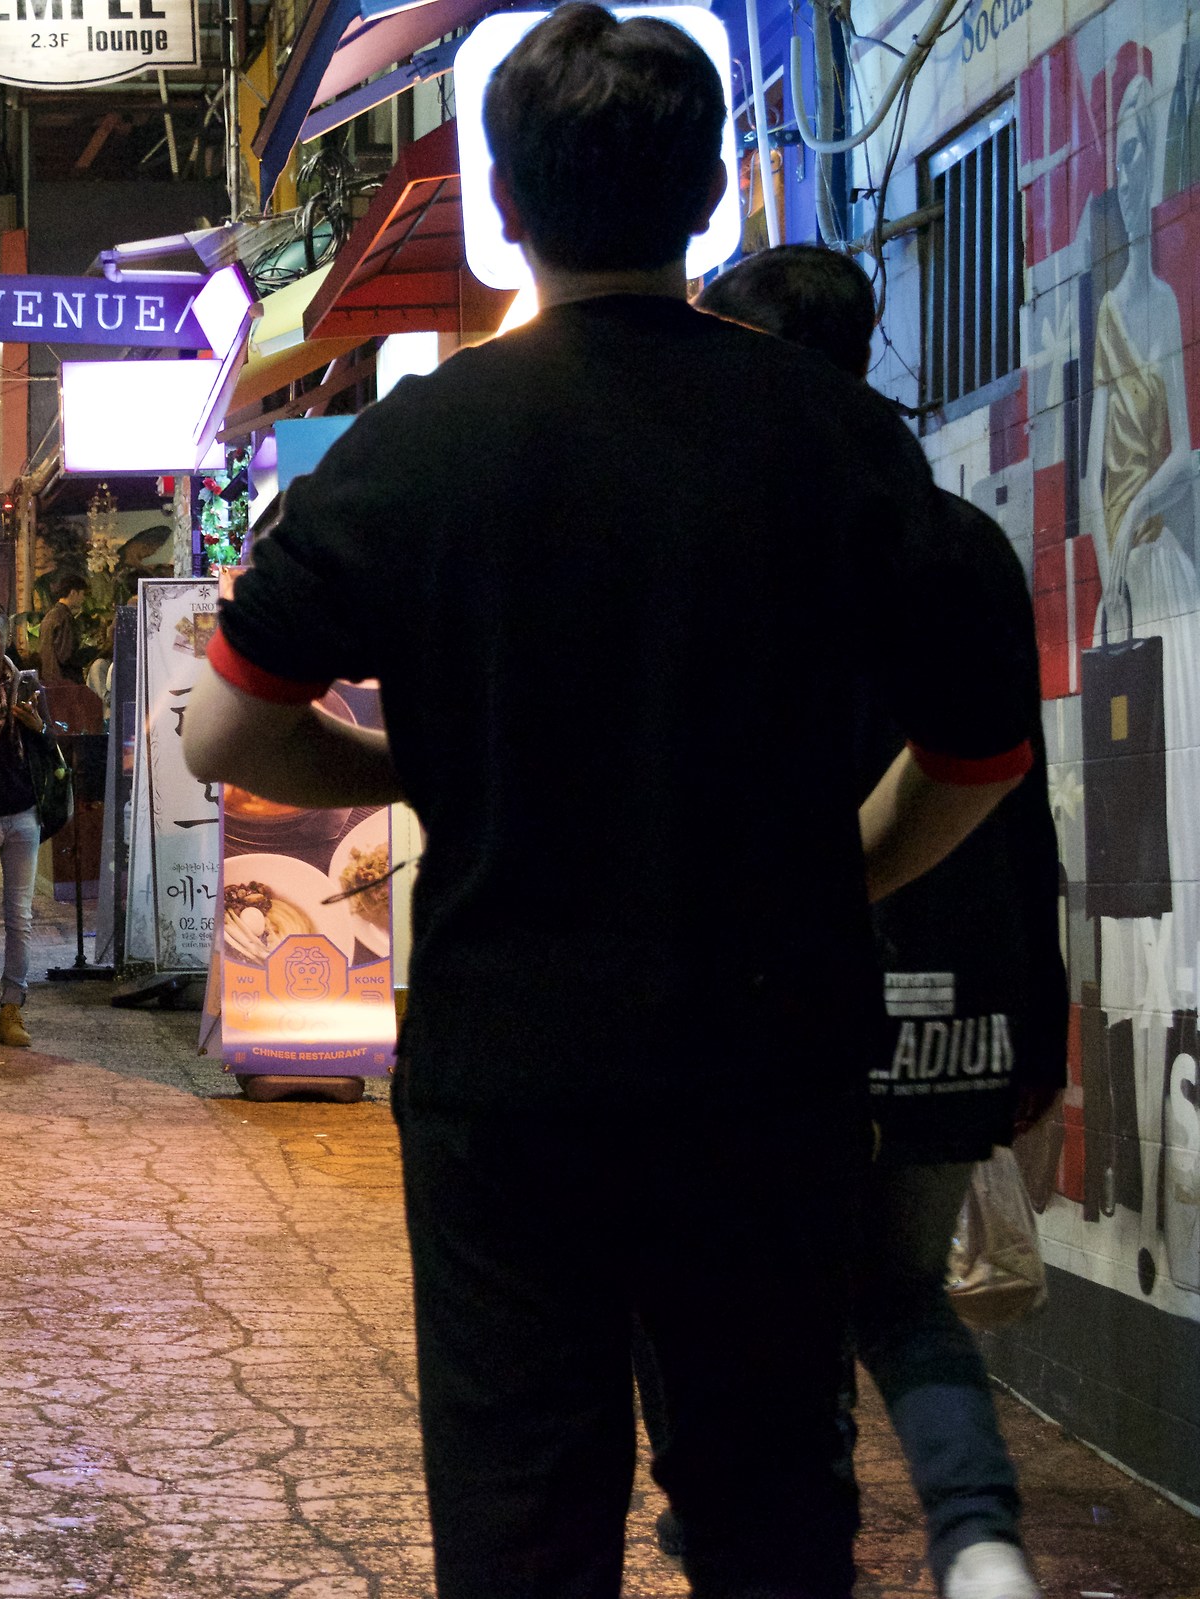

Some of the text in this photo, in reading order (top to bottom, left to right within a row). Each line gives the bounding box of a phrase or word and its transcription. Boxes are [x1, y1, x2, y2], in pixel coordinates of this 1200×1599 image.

[30, 26, 168, 54] 2.3F lounge
[237, 976, 385, 984] WU KONG
[252, 1047, 297, 1060] CHINESE
[298, 1047, 368, 1061] RESTAURANT
